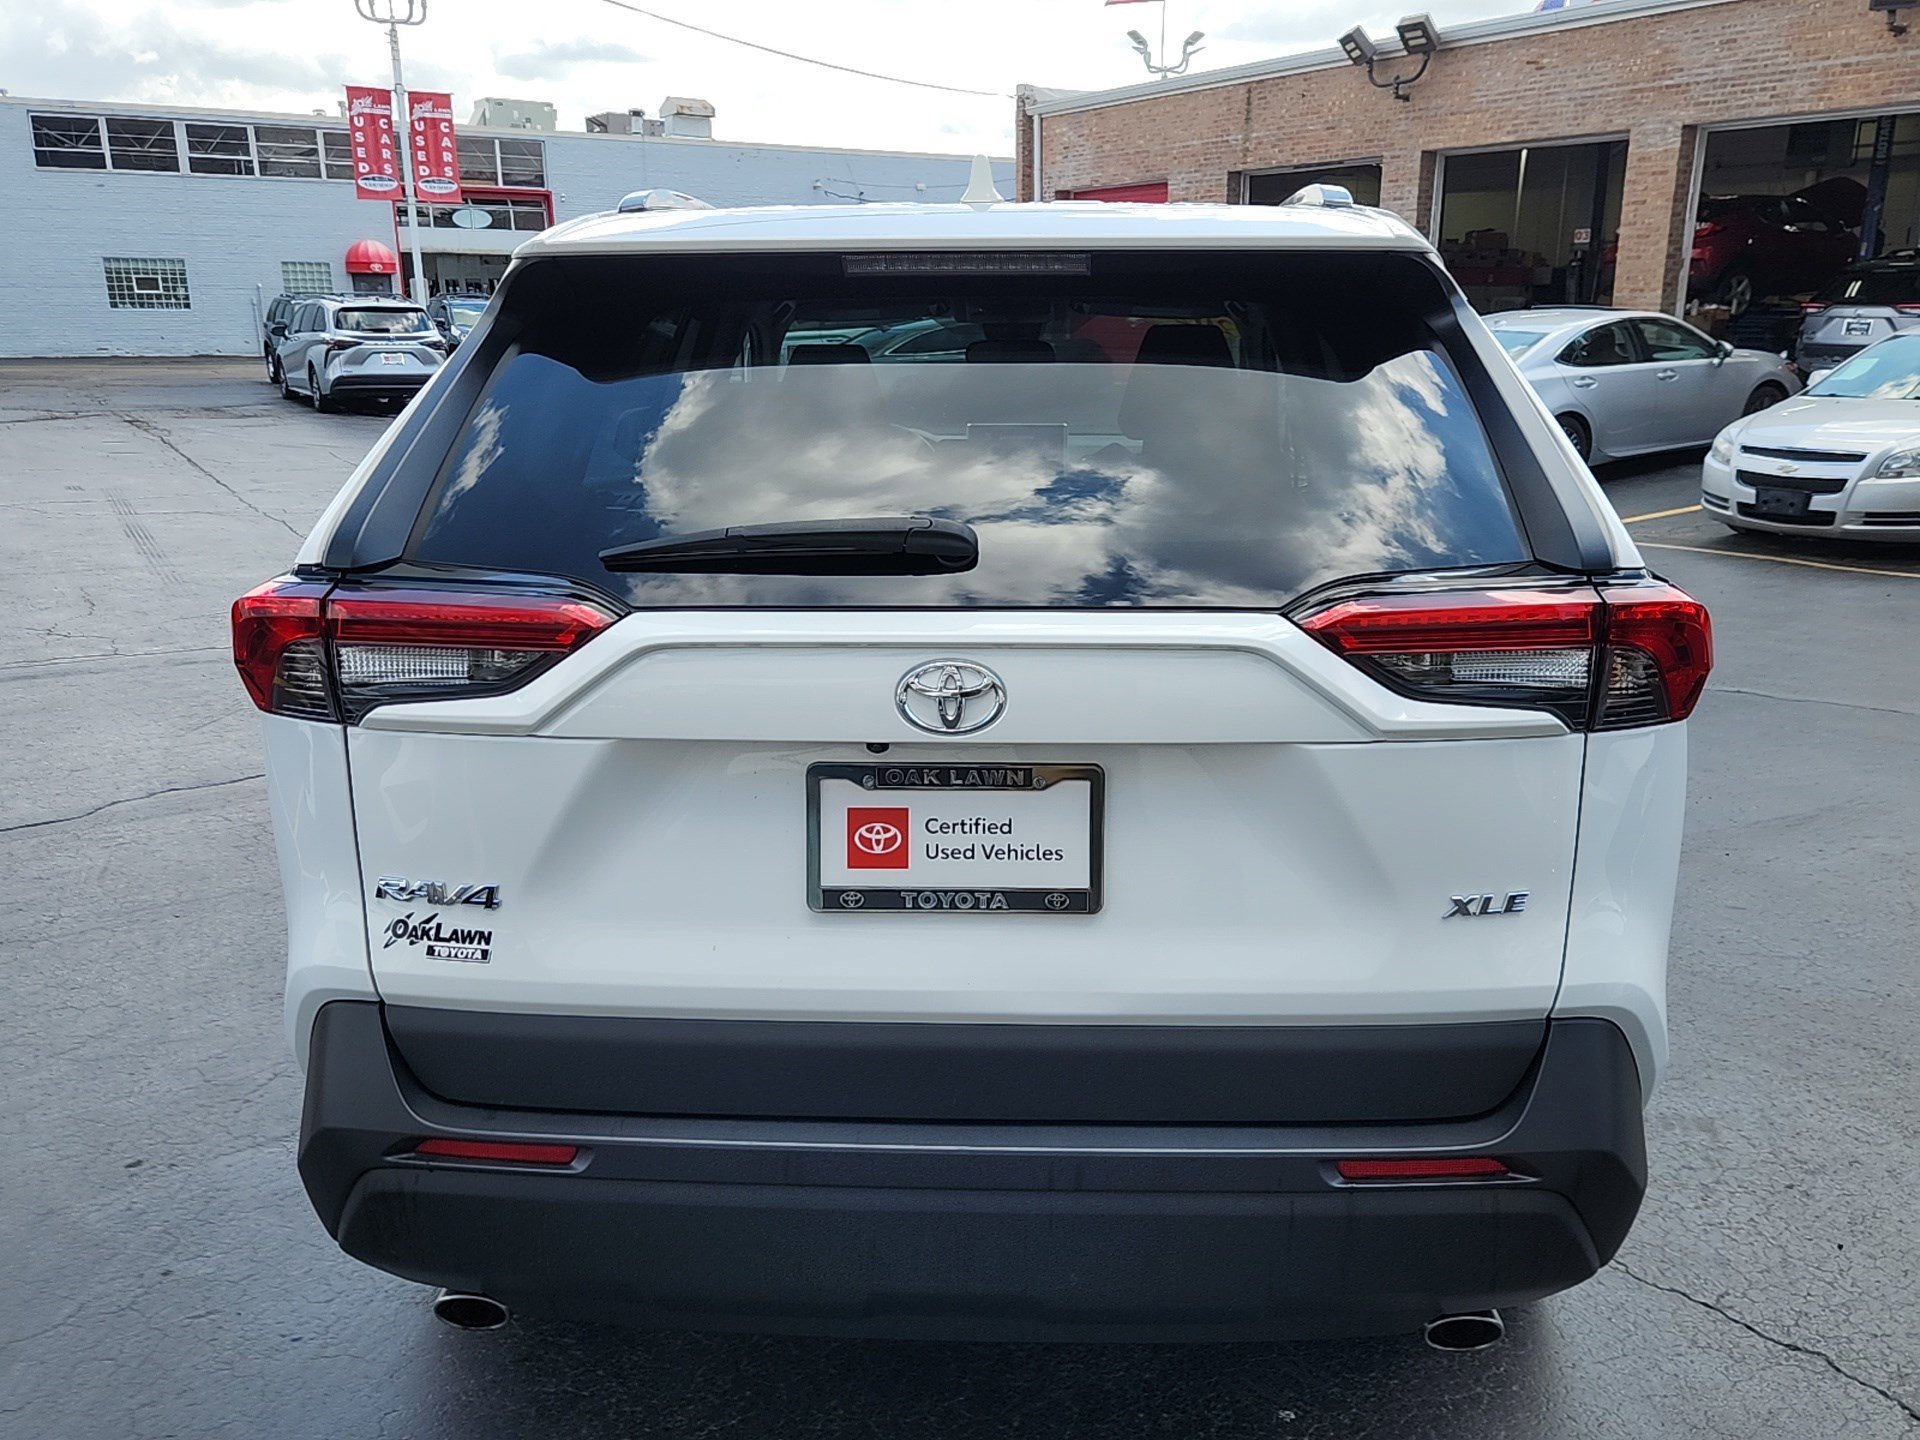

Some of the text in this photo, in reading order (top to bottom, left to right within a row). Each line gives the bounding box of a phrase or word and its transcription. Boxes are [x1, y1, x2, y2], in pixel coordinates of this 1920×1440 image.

[353, 116, 394, 175] USED CARS
[414, 120, 454, 177] USED CARS
[885, 768, 1025, 786] OAK LAWN
[925, 818, 1013, 835] Certified
[925, 843, 1064, 861] Used Vehicles
[375, 876, 502, 911] RAV4
[900, 891, 1010, 910] TOYOTA
[1442, 890, 1530, 919] XLE
[433, 946, 483, 960] TOYOTA
